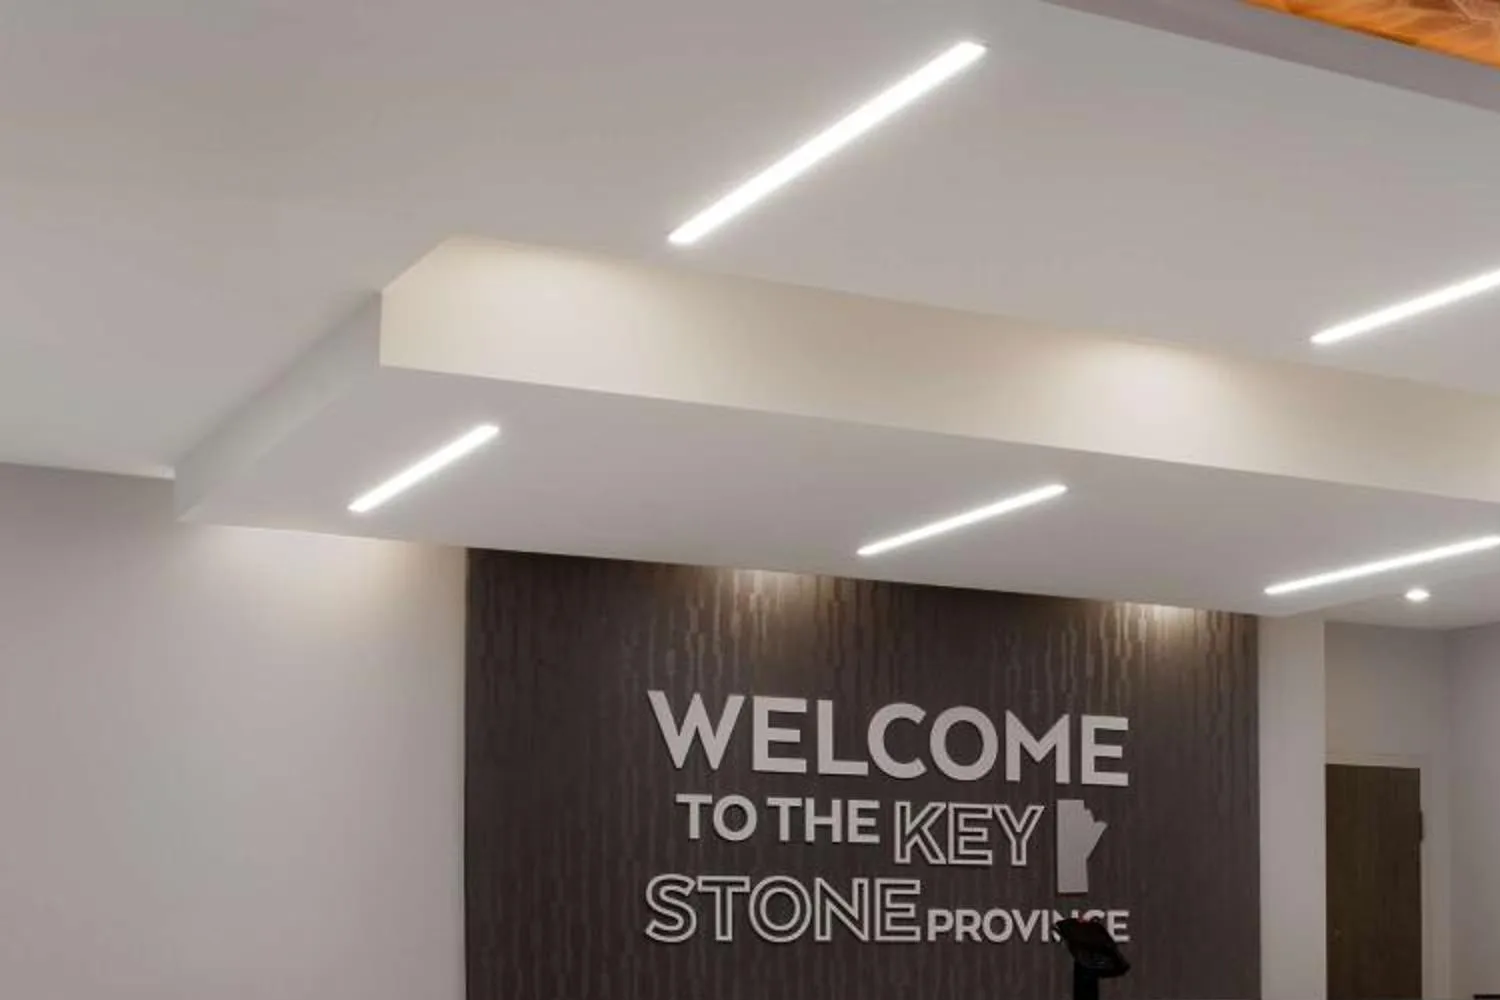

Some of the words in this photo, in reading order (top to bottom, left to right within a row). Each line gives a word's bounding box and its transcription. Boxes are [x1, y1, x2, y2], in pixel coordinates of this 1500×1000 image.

[647, 690, 1130, 787] WELCOME
[675, 792, 758, 842] TO
[766, 796, 881, 844] THE
[893, 800, 1045, 867] KEY
[645, 873, 921, 944] STONE
